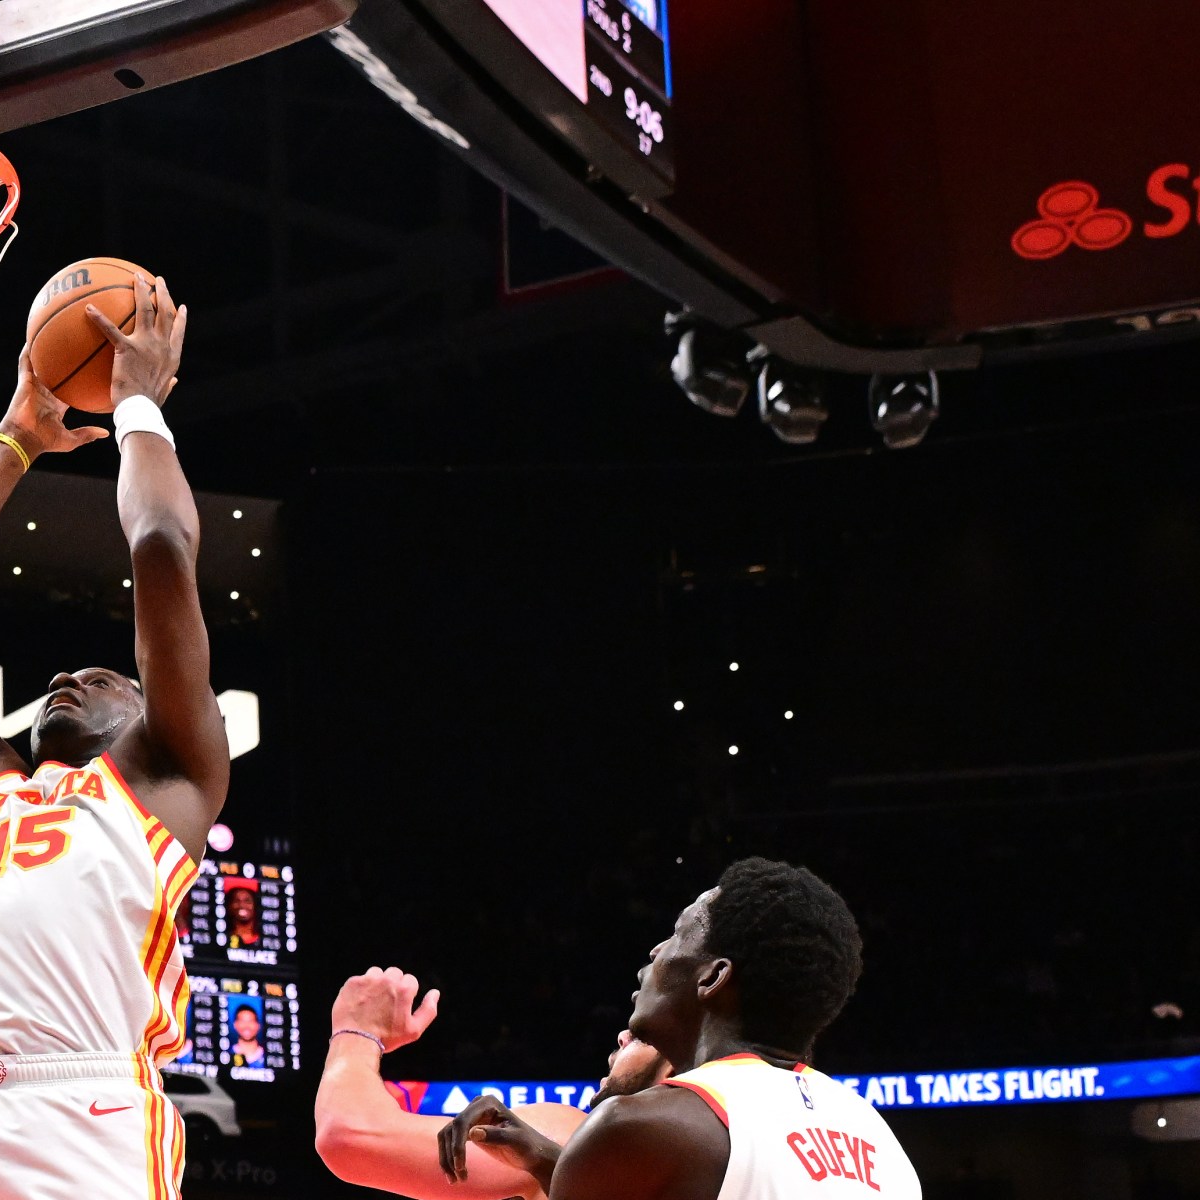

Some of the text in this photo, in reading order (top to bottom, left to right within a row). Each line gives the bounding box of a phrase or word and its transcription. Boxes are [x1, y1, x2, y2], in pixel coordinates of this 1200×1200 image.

[623, 87, 664, 143] 9:06
[227, 948, 278, 966] WALLACE
[864, 1076, 914, 1106] ATL
[916, 1073, 1001, 1104] TAKES
[1004, 1067, 1104, 1100] FLIGHT.
[787, 1128, 881, 1192] GUEYE
